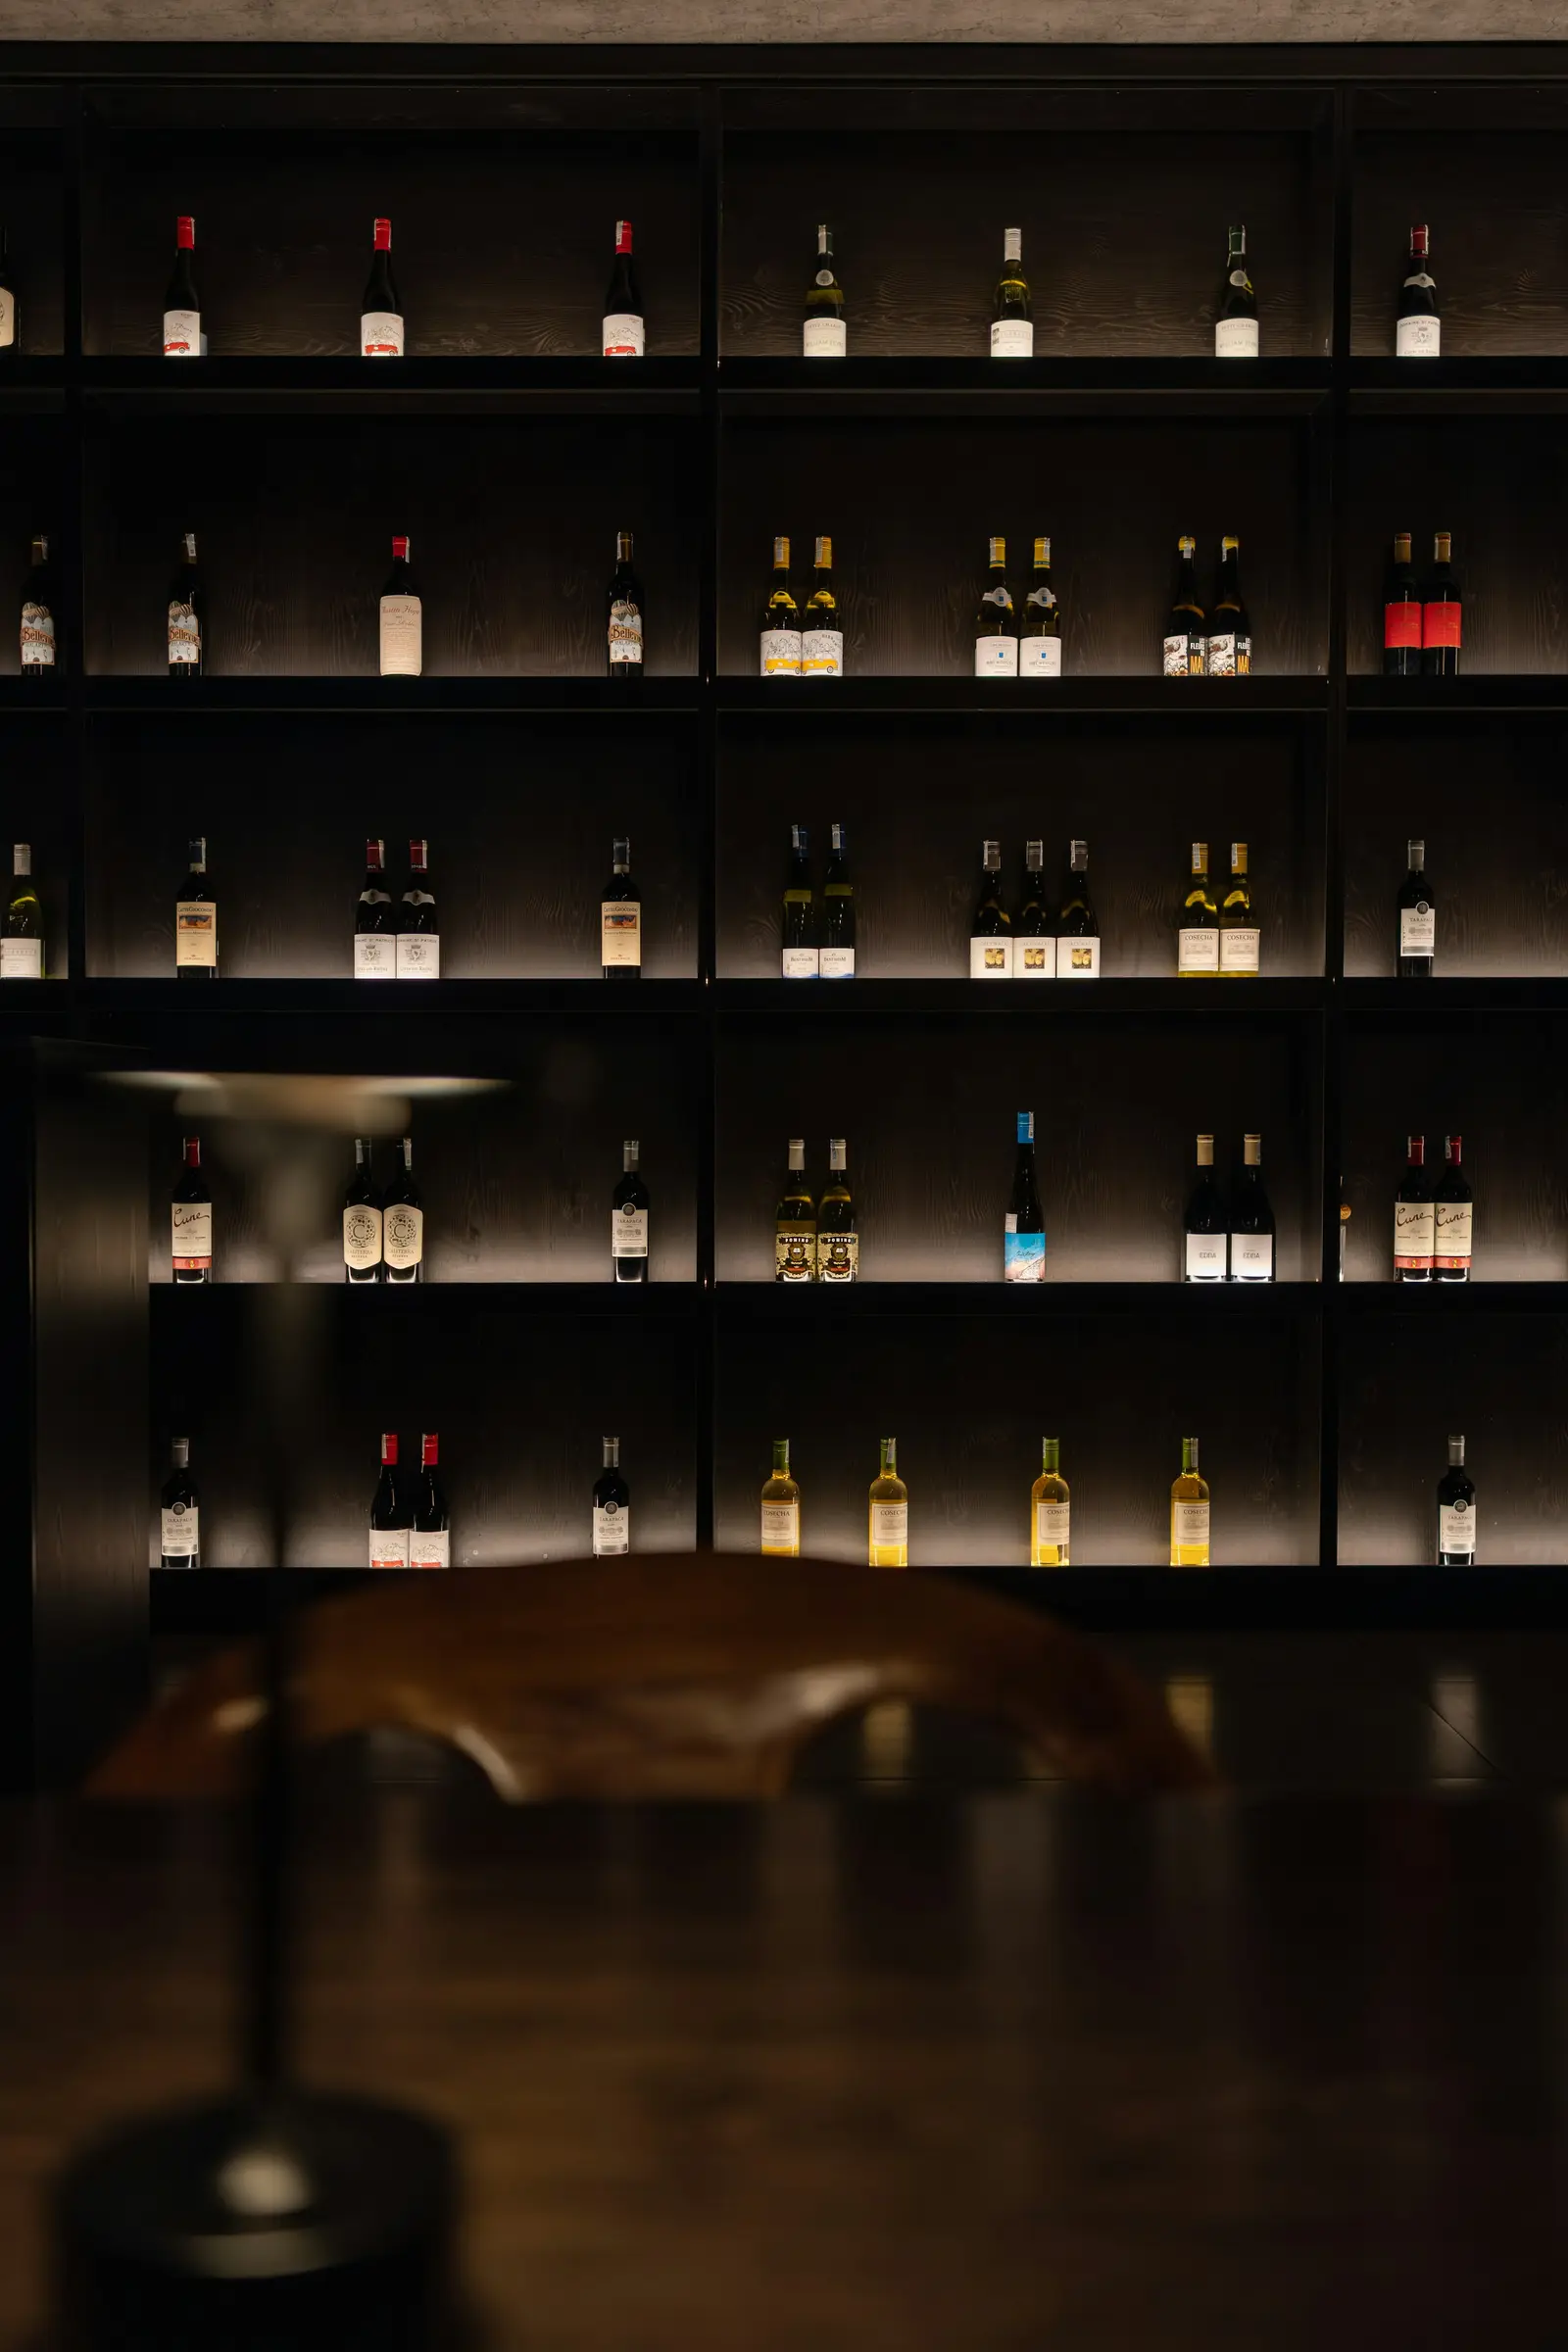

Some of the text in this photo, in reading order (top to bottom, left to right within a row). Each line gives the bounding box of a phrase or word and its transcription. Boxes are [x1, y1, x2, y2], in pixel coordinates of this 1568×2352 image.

[173, 1207, 210, 1227] Cune
[1396, 1207, 1433, 1227] Cune
[1437, 1207, 1472, 1227] Cune
